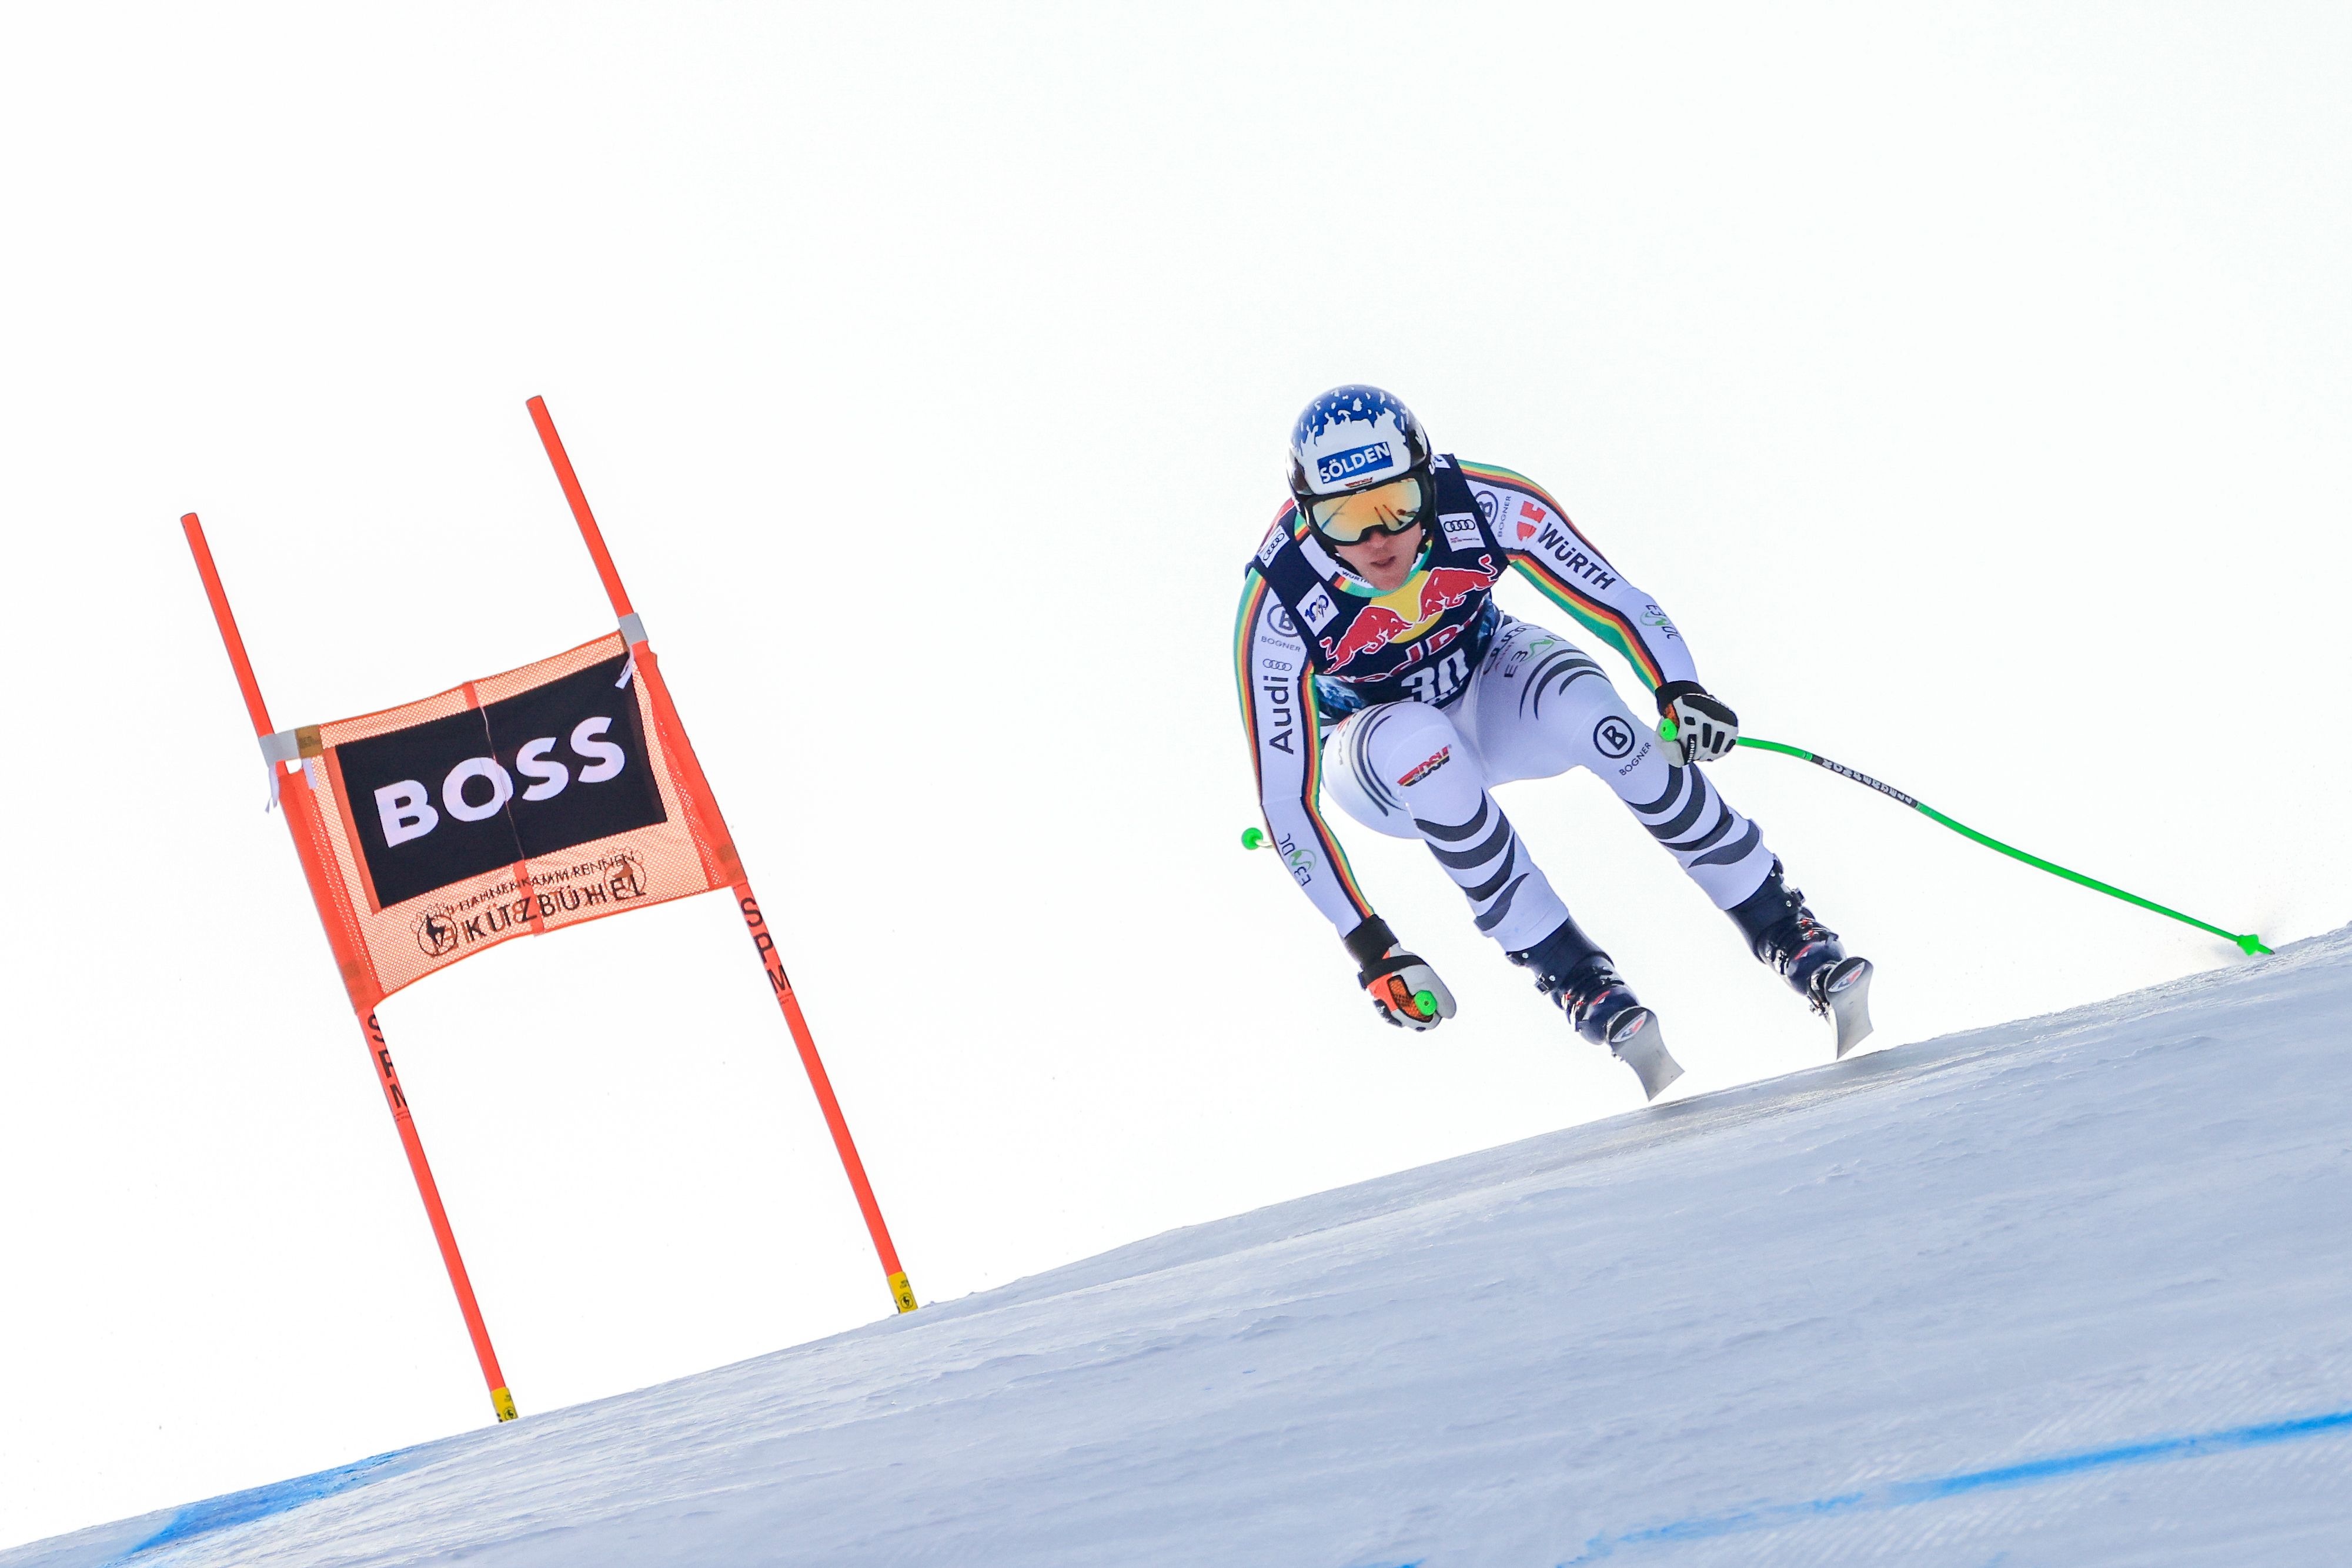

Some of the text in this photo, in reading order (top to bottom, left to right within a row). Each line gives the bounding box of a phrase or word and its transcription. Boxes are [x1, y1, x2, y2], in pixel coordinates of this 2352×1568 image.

[1319, 442, 1390, 483] SÖLDEN
[1497, 496, 1512, 537] BOGNER
[1538, 522, 1616, 590] WÜRTH
[1261, 636, 1301, 652] BOGNER
[1400, 648, 1469, 703] 30
[1263, 676, 1294, 755] Audi
[373, 716, 625, 848] BOSS
[1619, 742, 1651, 776] BOGNER
[740, 897, 791, 994] SPM
